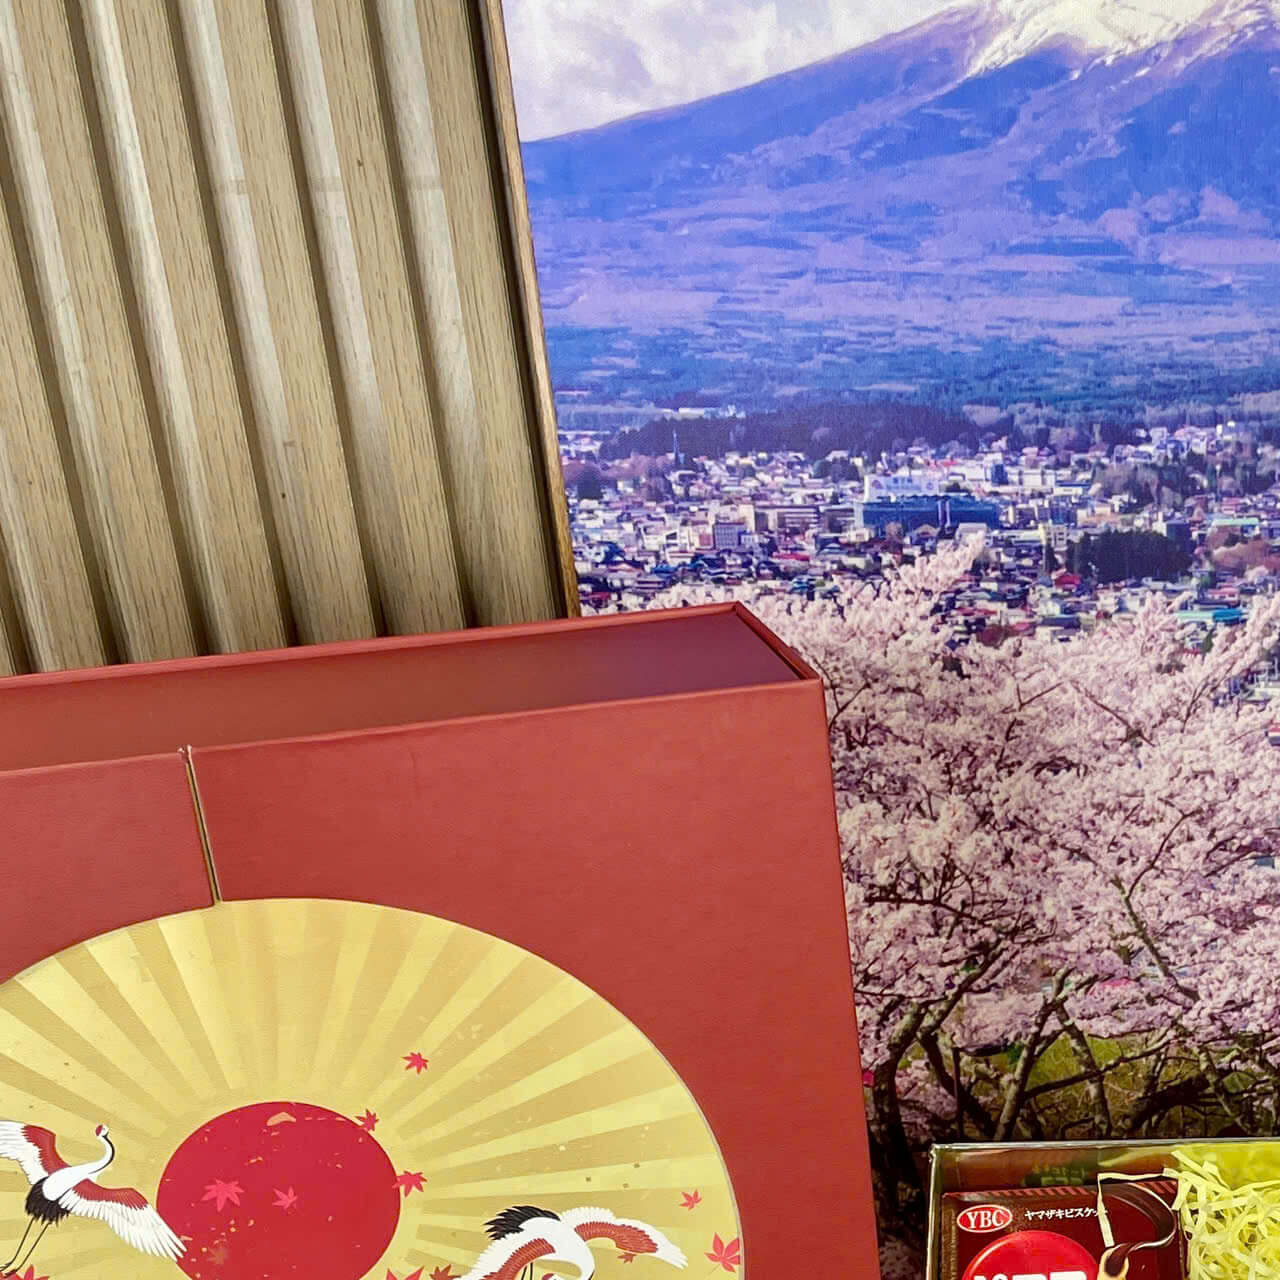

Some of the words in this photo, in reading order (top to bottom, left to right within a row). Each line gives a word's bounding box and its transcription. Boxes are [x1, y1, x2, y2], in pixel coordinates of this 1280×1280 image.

[966, 1210, 1004, 1230] YBC
[1024, 1207, 1108, 1221] ヤマザキビスケッ
